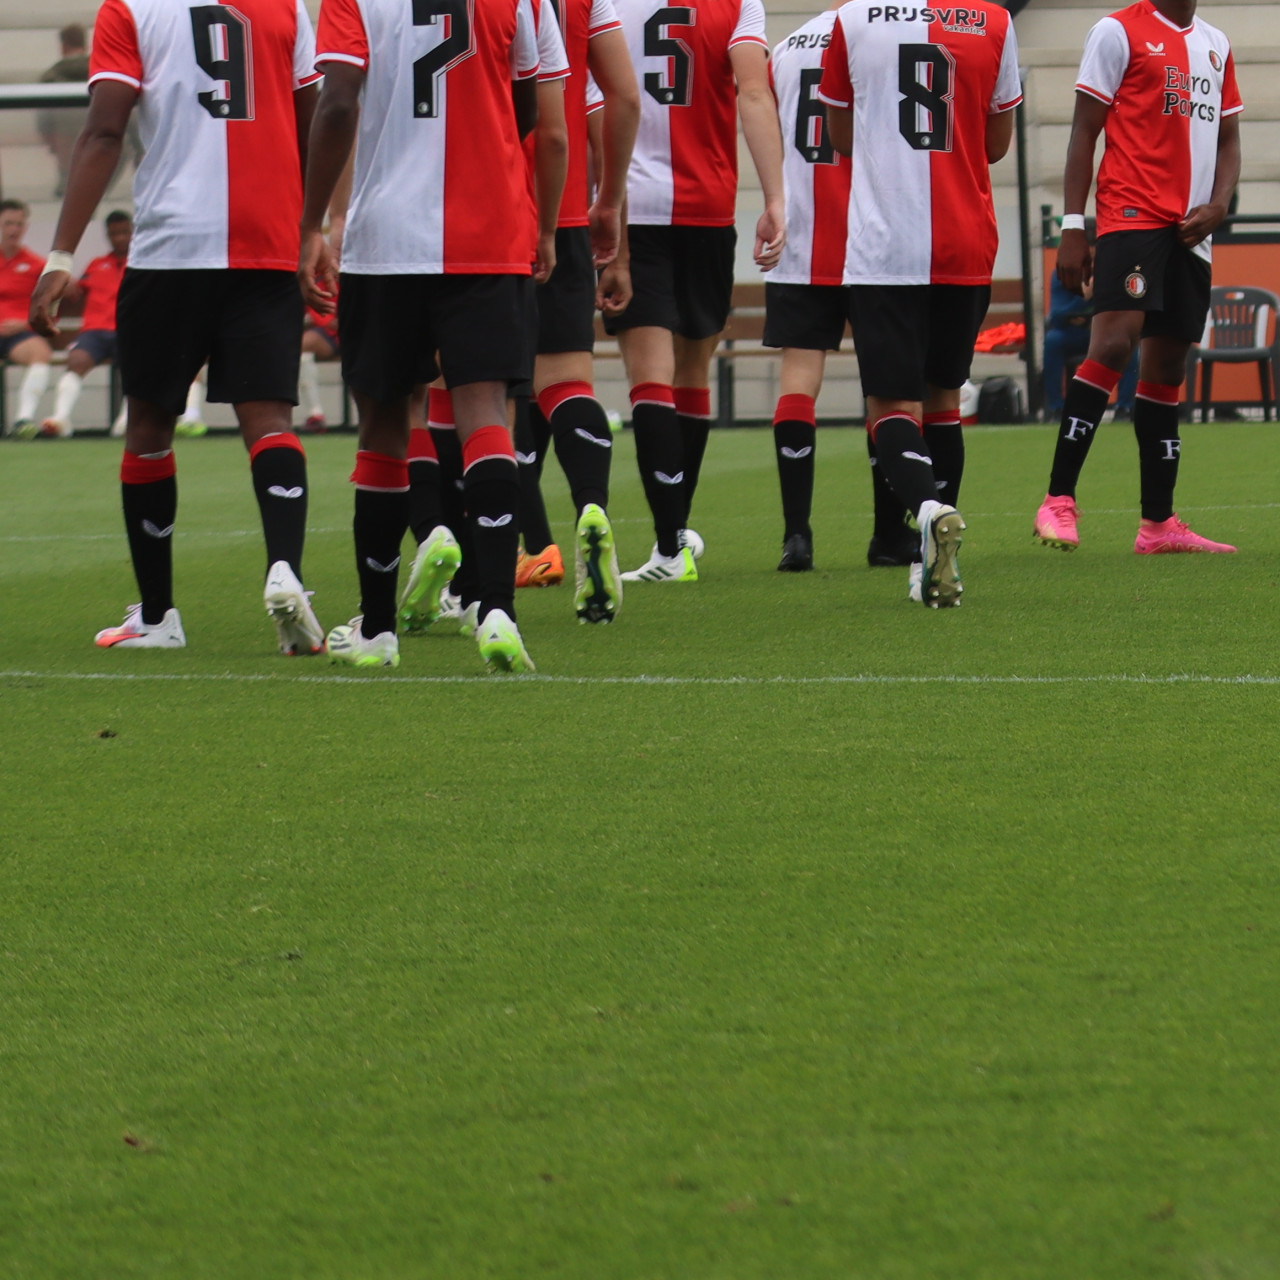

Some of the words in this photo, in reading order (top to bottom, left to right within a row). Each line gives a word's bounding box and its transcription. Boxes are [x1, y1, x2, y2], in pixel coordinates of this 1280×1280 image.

[868, 5, 986, 28] PRIJSVRIJ
[942, 24, 986, 36] vakanties
[644, 6, 696, 106] 5
[787, 33, 832, 51] PRIJS
[189, 4, 255, 121] 9
[1165, 66, 1210, 95] Euro
[898, 43, 956, 152] 8
[1162, 91, 1215, 122] Parcs
[795, 68, 840, 165] 6
[1064, 416, 1094, 441] F
